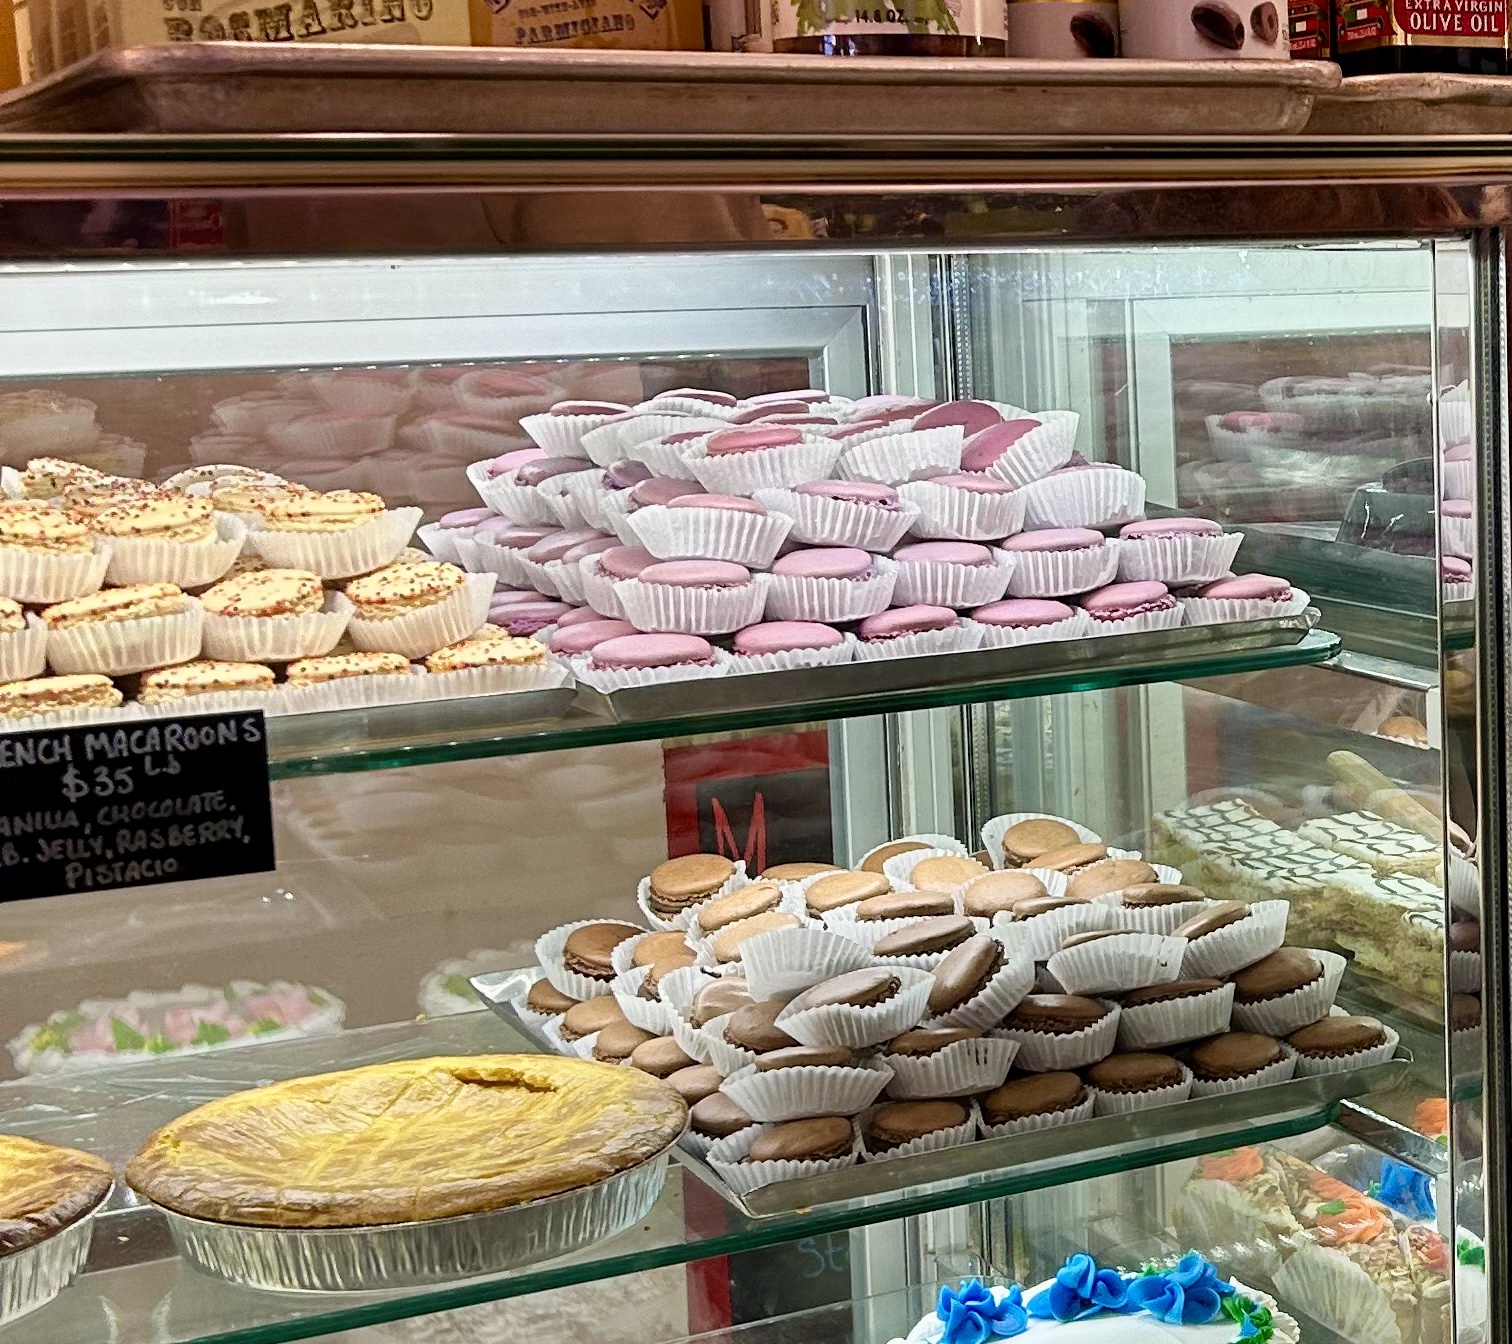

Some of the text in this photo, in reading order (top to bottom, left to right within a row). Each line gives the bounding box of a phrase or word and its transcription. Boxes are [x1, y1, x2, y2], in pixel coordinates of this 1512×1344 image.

[1455, 0, 1503, 12] VIRGIN
[1410, 13, 1499, 32] OLIVE OIL
[84, 718, 262, 761] MACAROONS
[61, 763, 134, 803] $35
[65, 858, 178, 889] PISTACIO
